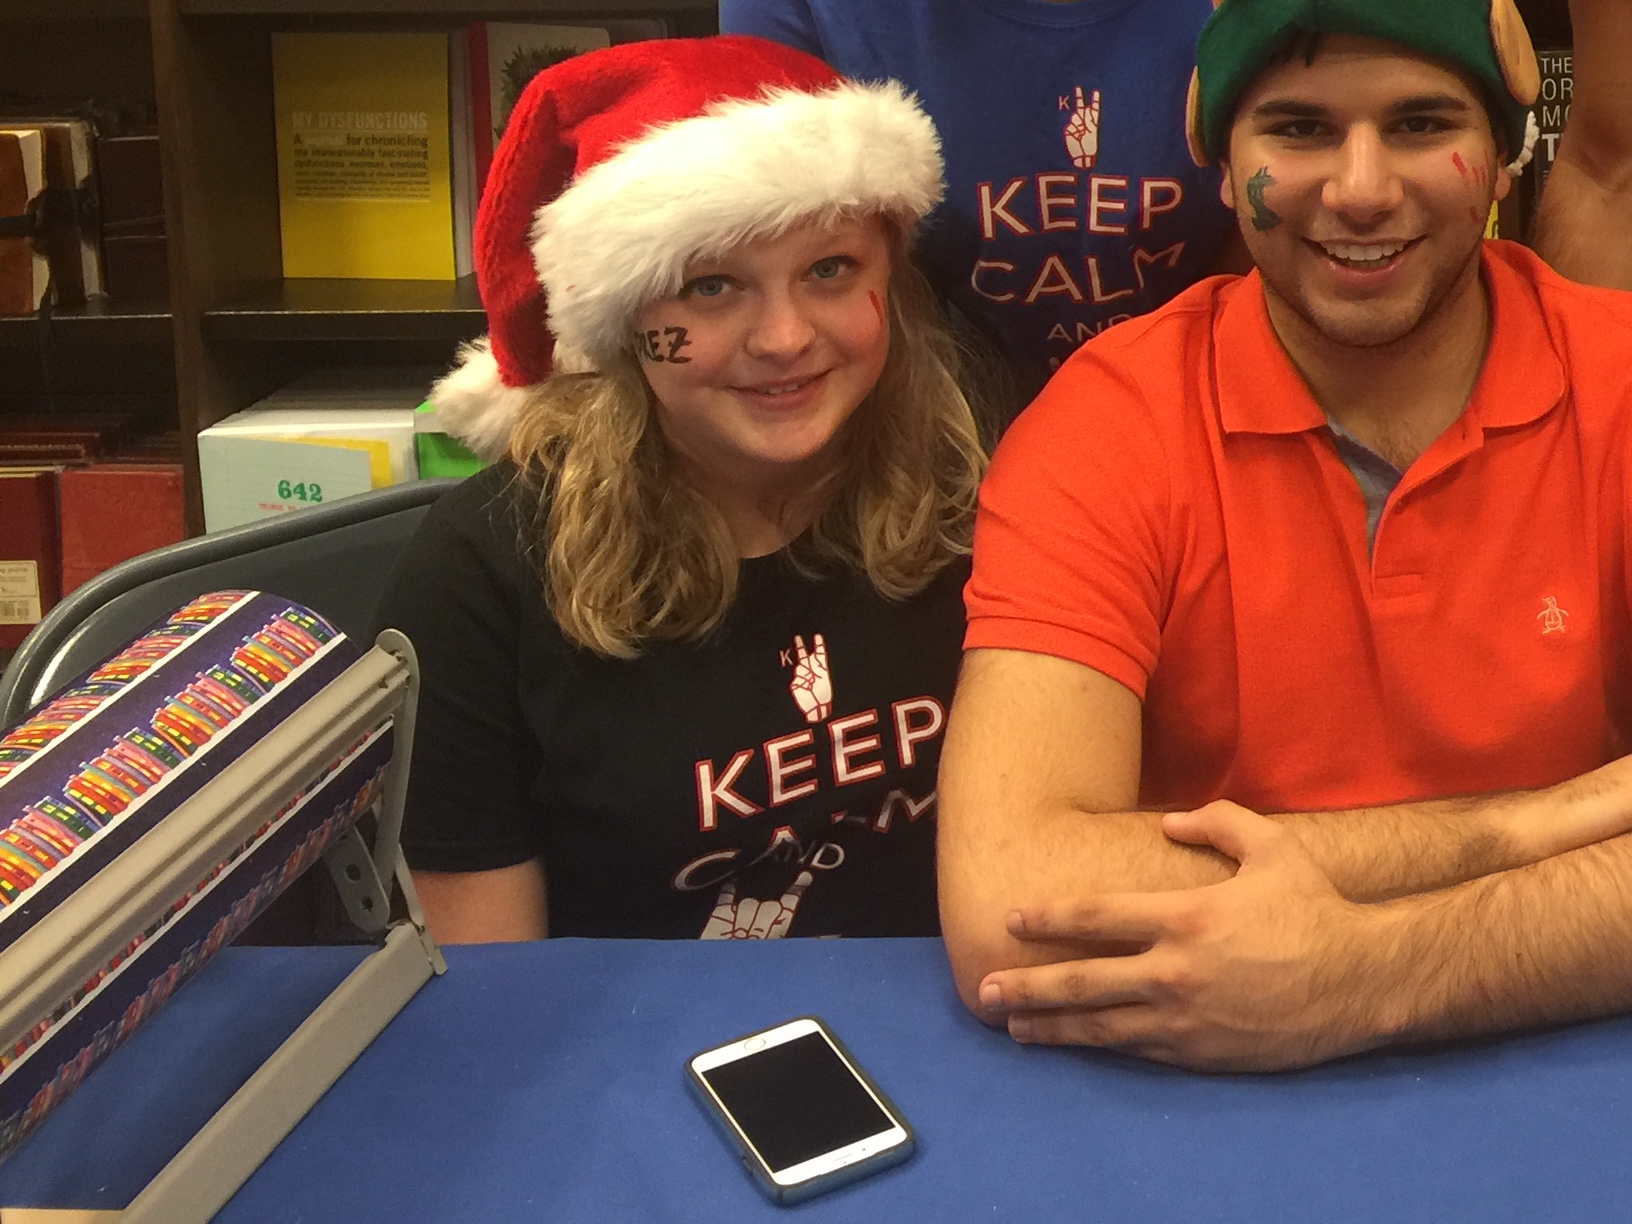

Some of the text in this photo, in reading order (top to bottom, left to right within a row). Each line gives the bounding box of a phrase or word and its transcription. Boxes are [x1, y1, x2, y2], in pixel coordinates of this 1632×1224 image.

[1541, 57, 1573, 73] THE
[1059, 96, 1070, 110] K
[977, 172, 1185, 241] KEEP
[971, 240, 1187, 305] CALM
[278, 479, 322, 502] 642
[779, 648, 792, 667] K
[695, 695, 946, 832] KEEP
